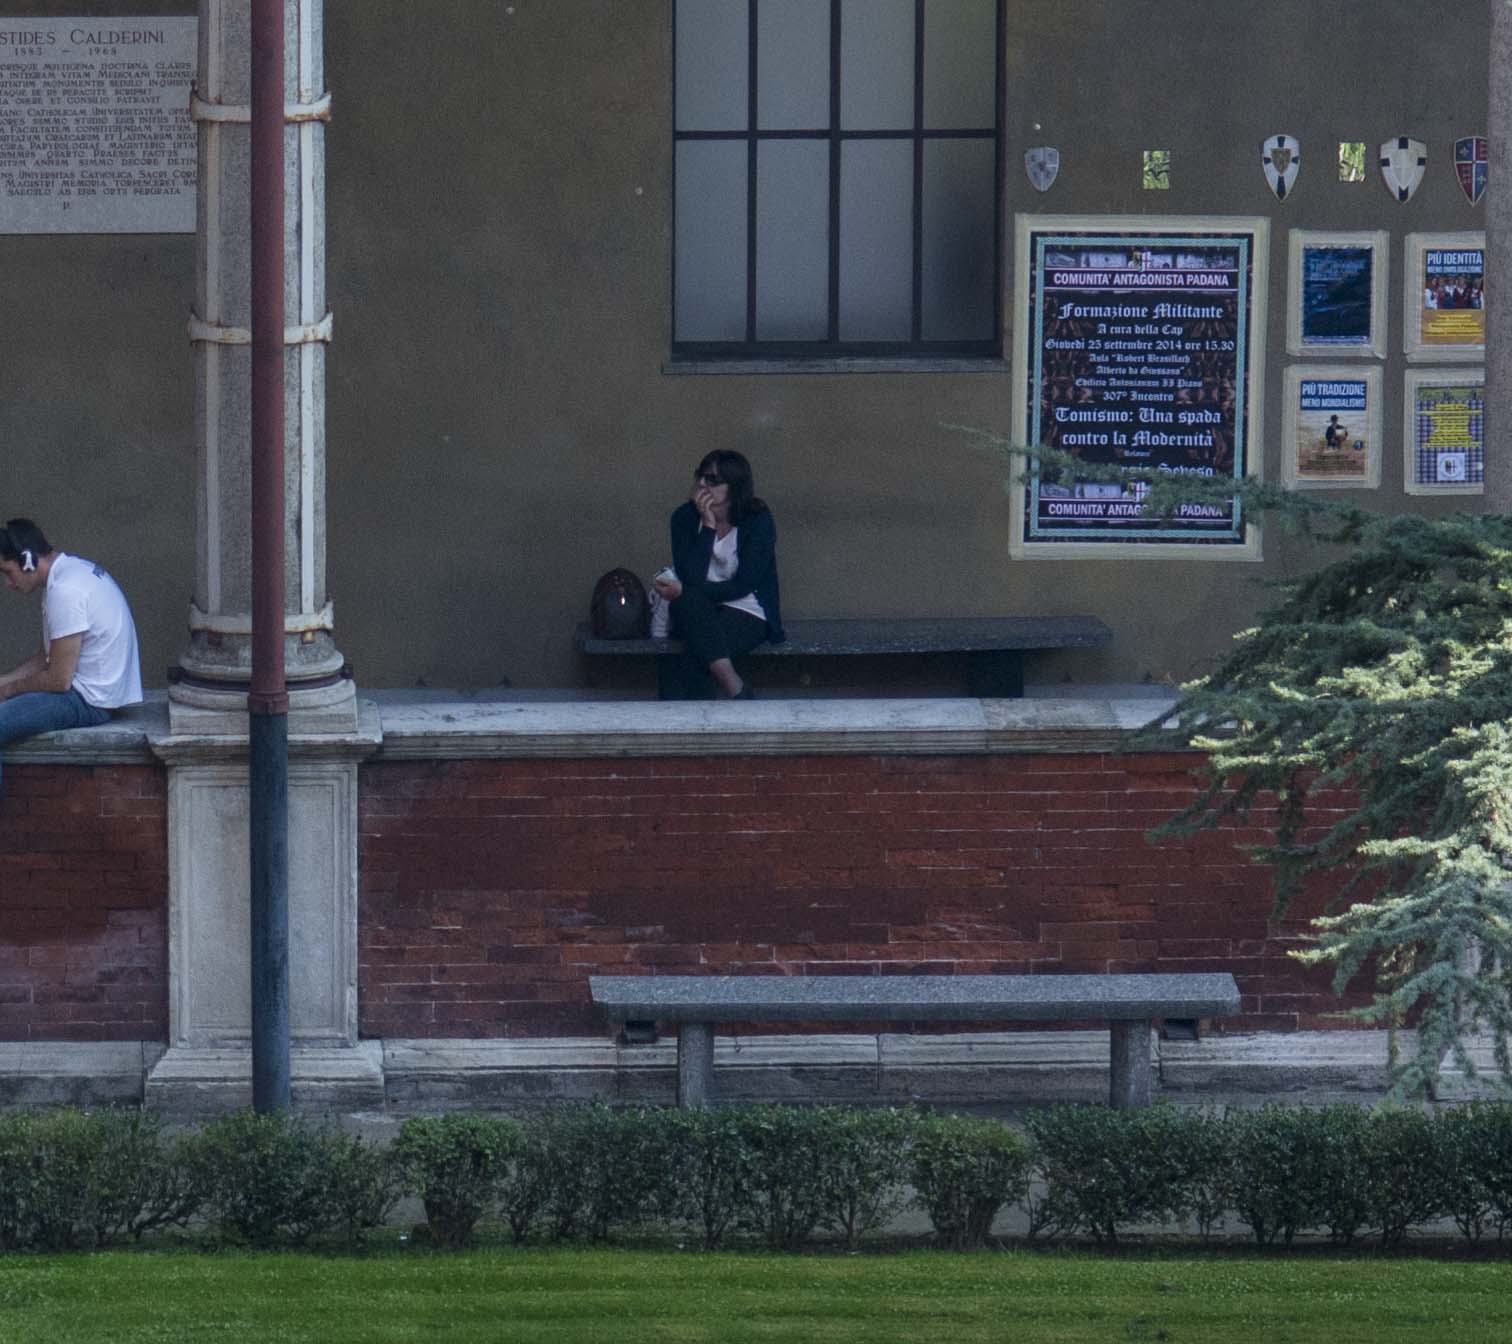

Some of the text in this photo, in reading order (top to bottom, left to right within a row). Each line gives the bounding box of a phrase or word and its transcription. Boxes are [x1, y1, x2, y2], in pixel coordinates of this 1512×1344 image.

[70, 29, 166, 45] CALDERINI
[1053, 272, 1229, 287] COMUNITA' ANTAGONISTA PADANA
[1058, 302, 1224, 319] Formazione Militante
[1110, 326, 1132, 335] cura
[1135, 323, 1159, 335] della
[1162, 324, 1184, 337] Cap
[1087, 339, 1103, 351] 25
[1104, 339, 1153, 351] settembre
[1155, 339, 1182, 351] 2014
[1184, 342, 1202, 351] ore
[1205, 339, 1235, 351] 15.30
[1130, 391, 1174, 402] Incontro
[1317, 383, 1365, 396] TRADIZIONE
[1055, 406, 1221, 426] Tomismo: Una spada
[1062, 429, 1213, 447] contro la Modernità
[1048, 503, 1224, 516] COMUNITA' ANTAGA PADANA
